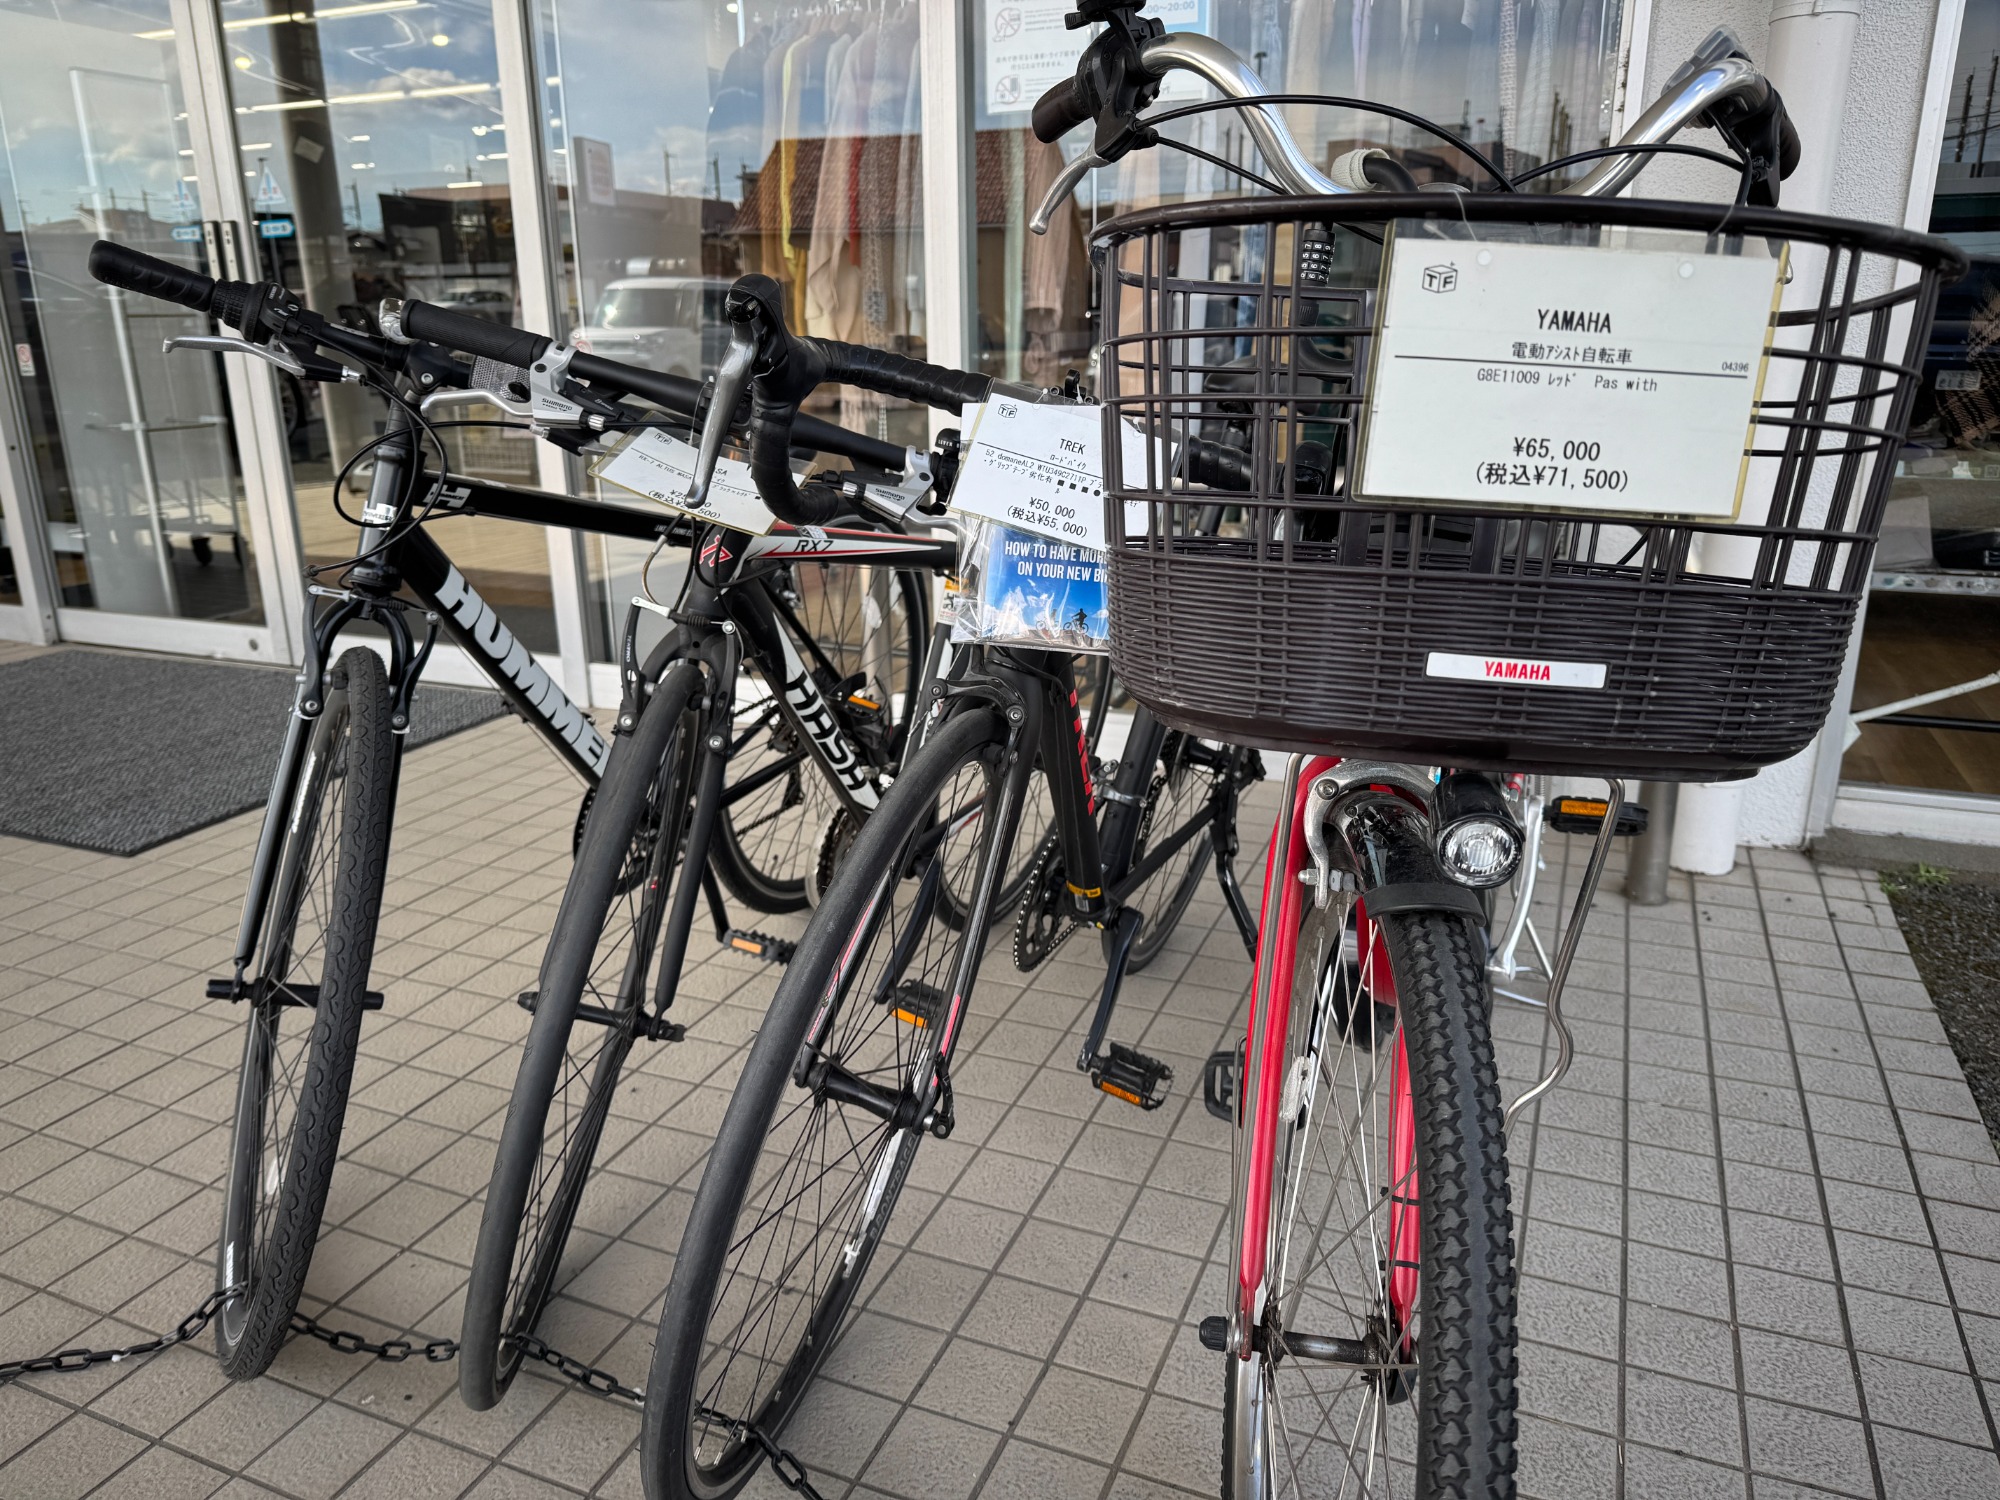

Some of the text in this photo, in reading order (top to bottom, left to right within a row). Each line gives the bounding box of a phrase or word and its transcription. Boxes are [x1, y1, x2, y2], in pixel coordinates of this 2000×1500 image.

[1538, 308, 1612, 333] YAMAHA
[1721, 361, 1749, 373] 04396
[1477, 368, 1540, 385] G8E11009
[1594, 375, 1618, 390] Pas
[1626, 377, 1658, 392] with
[1060, 438, 1086, 455] TREK
[1513, 436, 1600, 462] ¥65,000
[1476, 461, 1629, 493] (税込¥71,500)
[1029, 497, 1075, 519] ¥50,000
[1007, 505, 1088, 538] (税込¥55,000)
[793, 539, 834, 553] RX7
[1004, 541, 1030, 557] HOW
[1033, 543, 1047, 558] TO
[1049, 545, 1077, 561] HAVE
[1017, 561, 1033, 576] ON
[1036, 562, 1064, 579] YOUR
[1066, 565, 1092, 581] NEW
[434, 564, 612, 778] HUMME
[1484, 661, 1550, 681] YAMAHA
[785, 670, 868, 790] HASA
[876, 1132, 917, 1228] BONTRAGE
